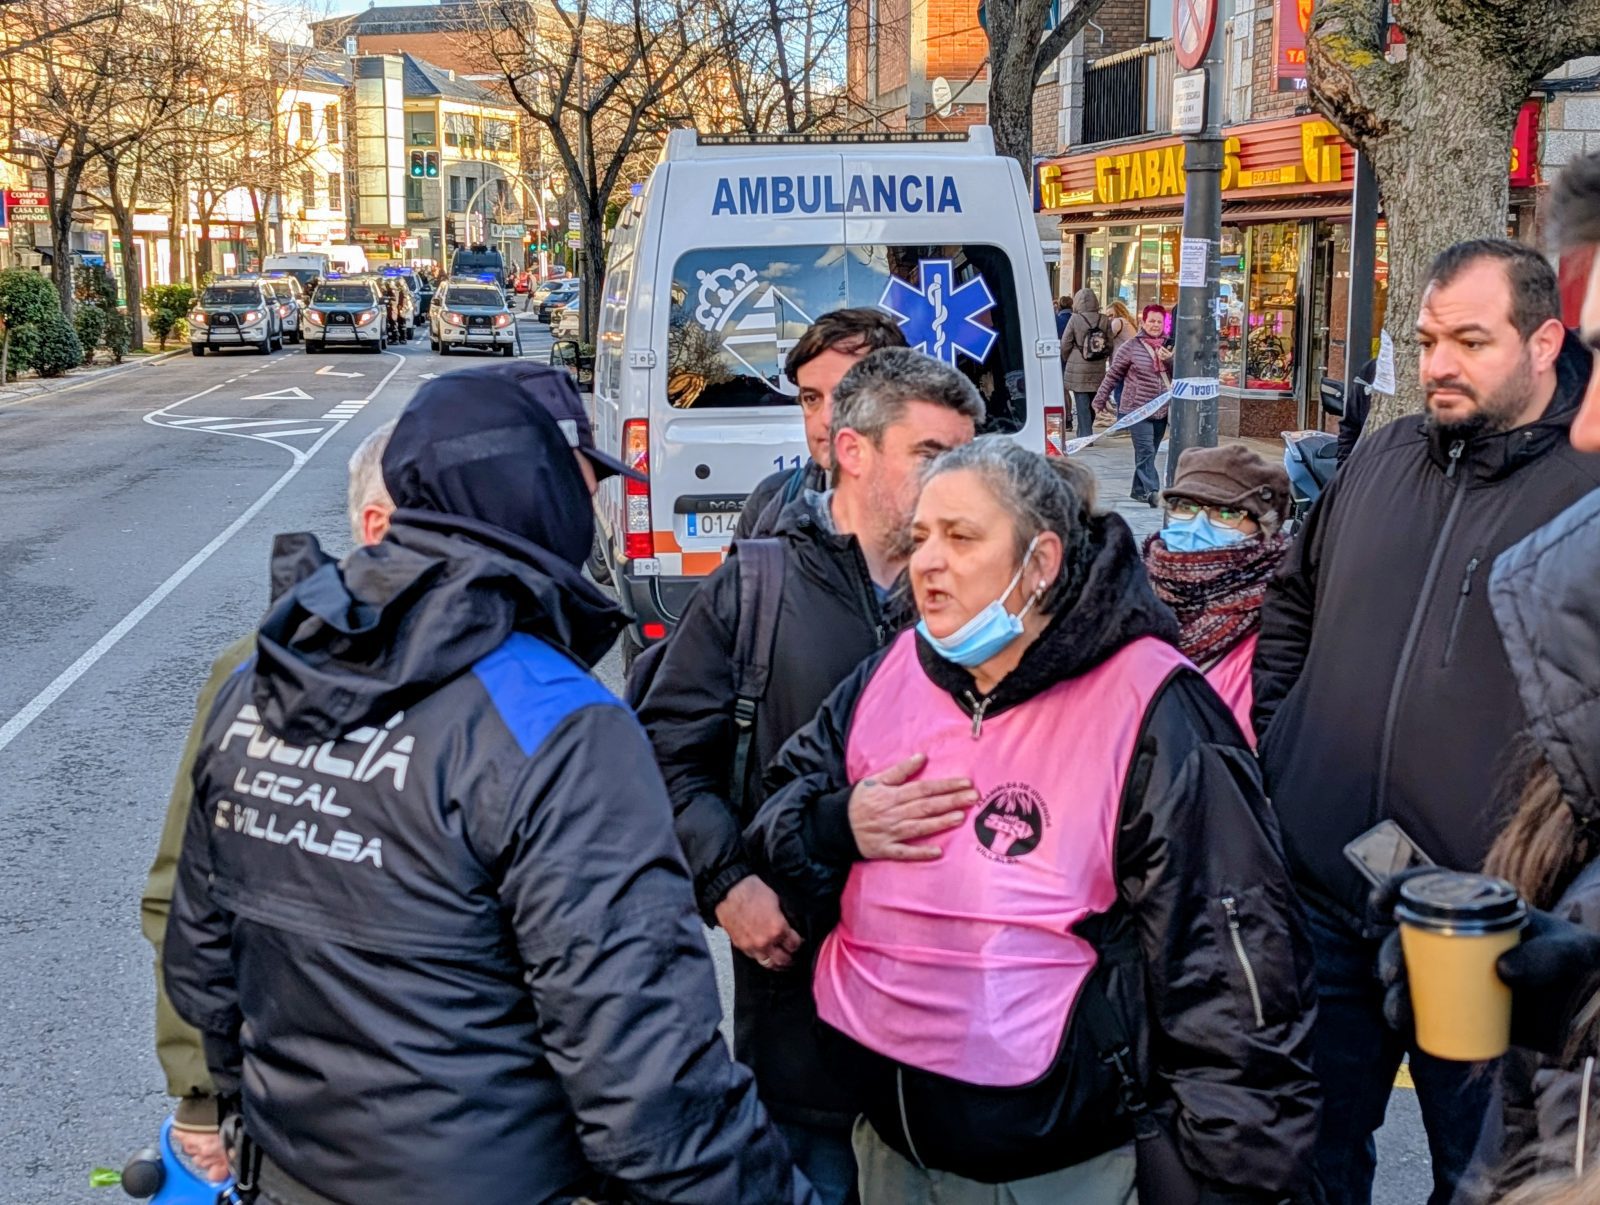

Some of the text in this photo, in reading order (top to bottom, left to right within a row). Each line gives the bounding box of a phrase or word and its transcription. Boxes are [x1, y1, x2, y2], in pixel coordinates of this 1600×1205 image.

[1287, 48, 1306, 64] TA
[1294, 78, 1308, 90] TA
[1118, 136, 1240, 201] TABAS
[711, 174, 963, 216] AMBULANCIA
[709, 501, 746, 510] MAS
[702, 515, 736, 534] 014
[233, 767, 351, 817] LOCAL
[234, 804, 383, 868] VILLALBA
